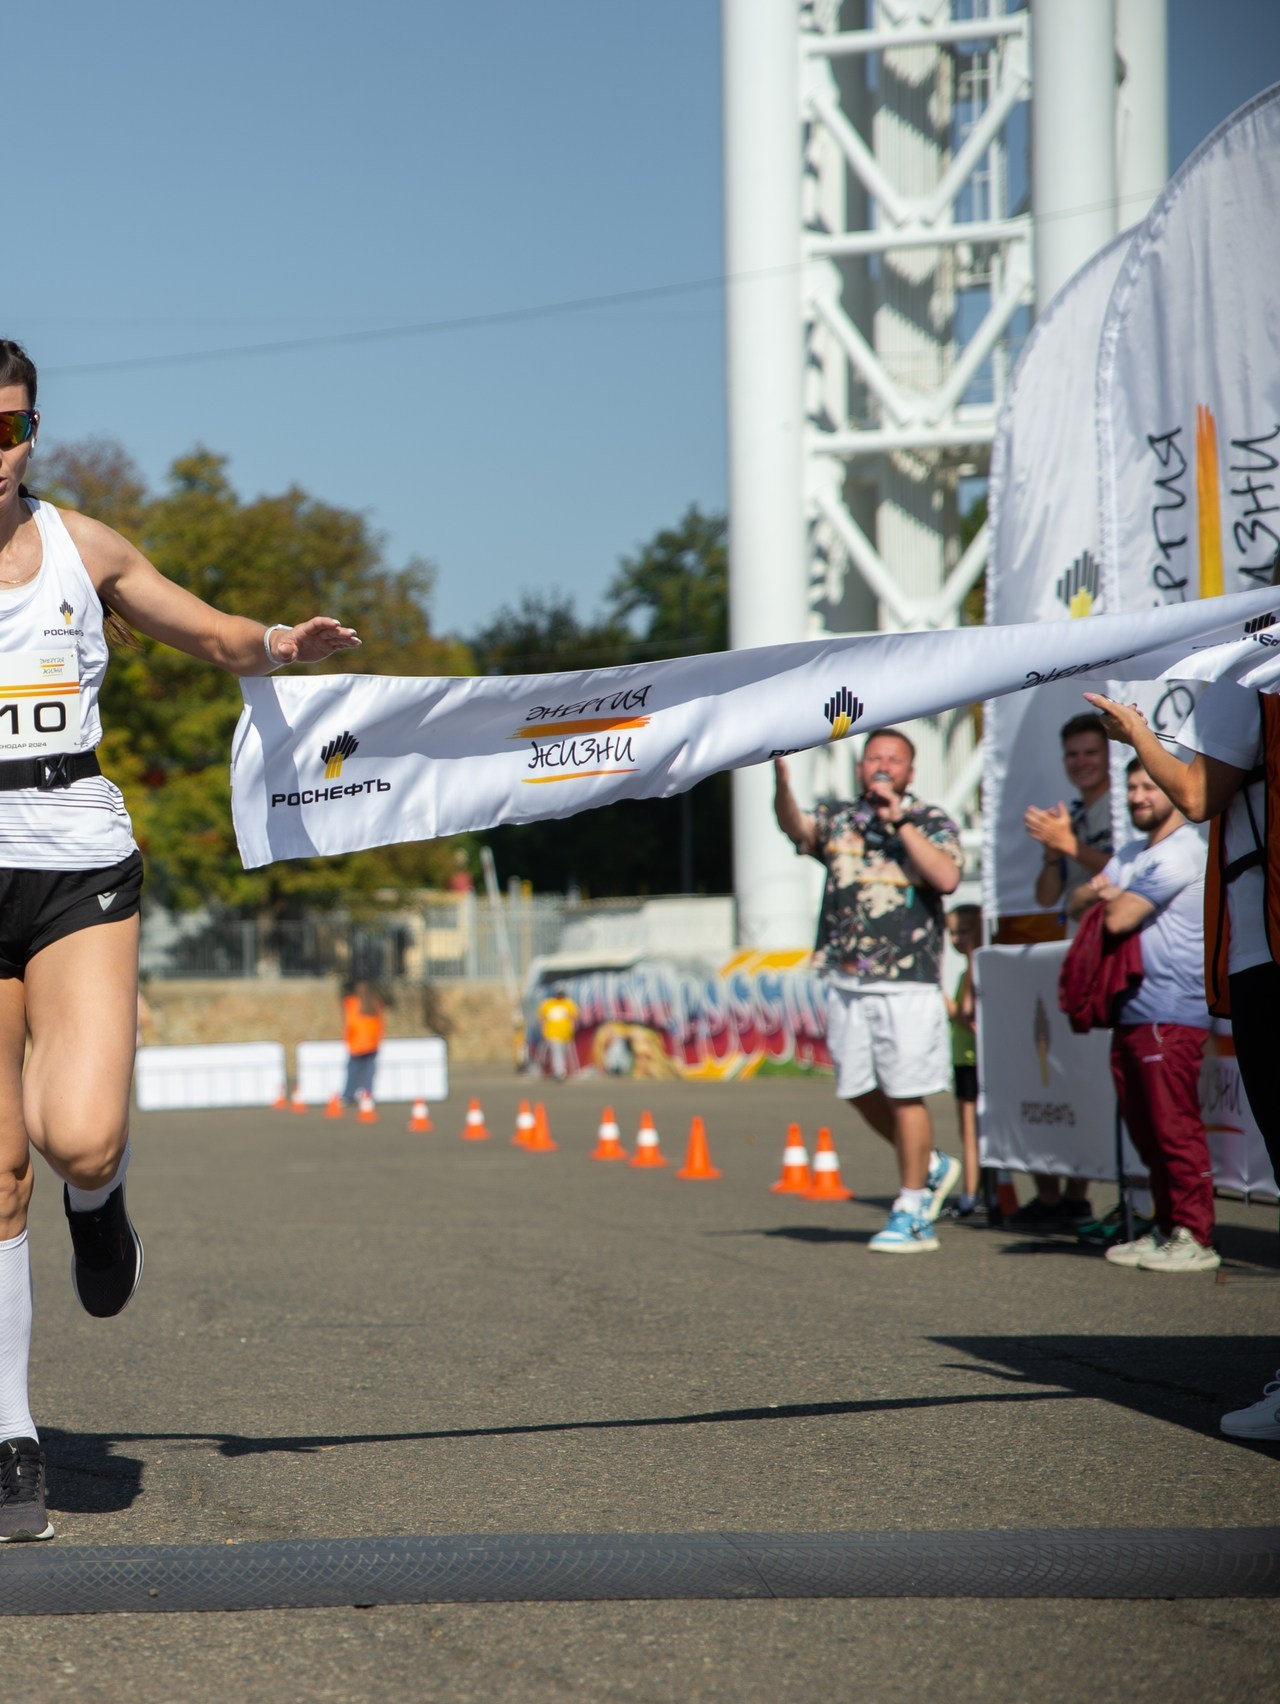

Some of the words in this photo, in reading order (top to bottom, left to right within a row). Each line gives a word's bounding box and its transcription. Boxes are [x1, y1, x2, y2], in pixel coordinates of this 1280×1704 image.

[525, 684, 654, 721] ЭНЕРГИЯ
[527, 736, 636, 770] ЖИЗНИ
[271, 778, 392, 808] РОСНЕФТЬ
